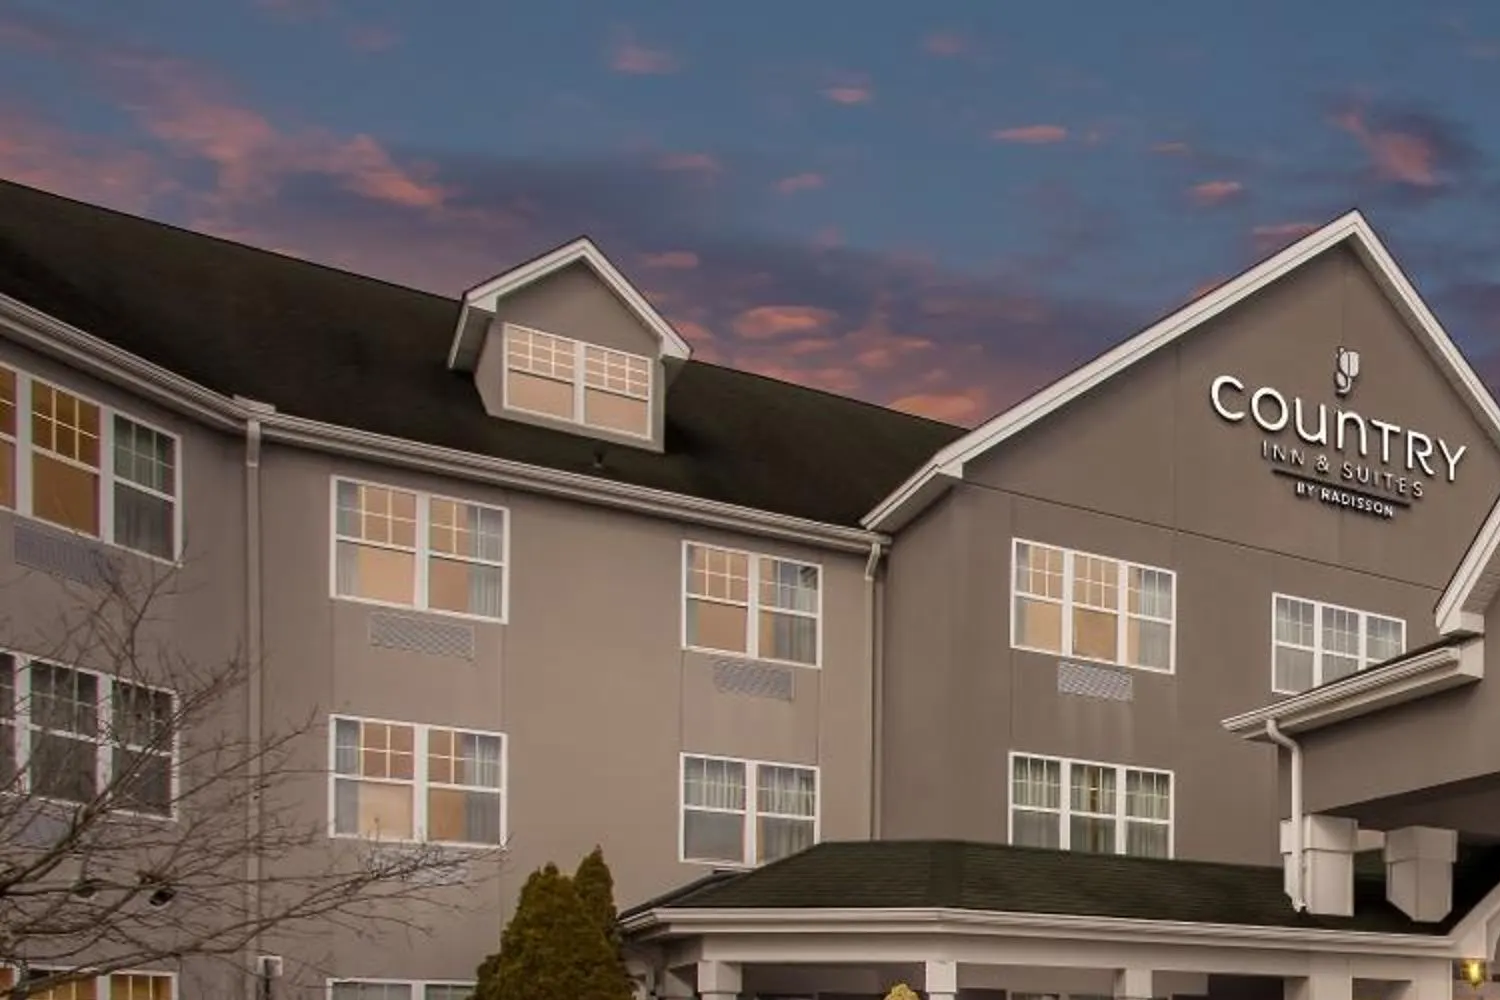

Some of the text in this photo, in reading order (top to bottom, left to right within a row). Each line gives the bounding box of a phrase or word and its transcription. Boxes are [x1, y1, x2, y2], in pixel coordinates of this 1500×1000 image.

[1263, 439, 1423, 498] INN & SUITES
[1296, 481, 1394, 518] BY RADISSON
